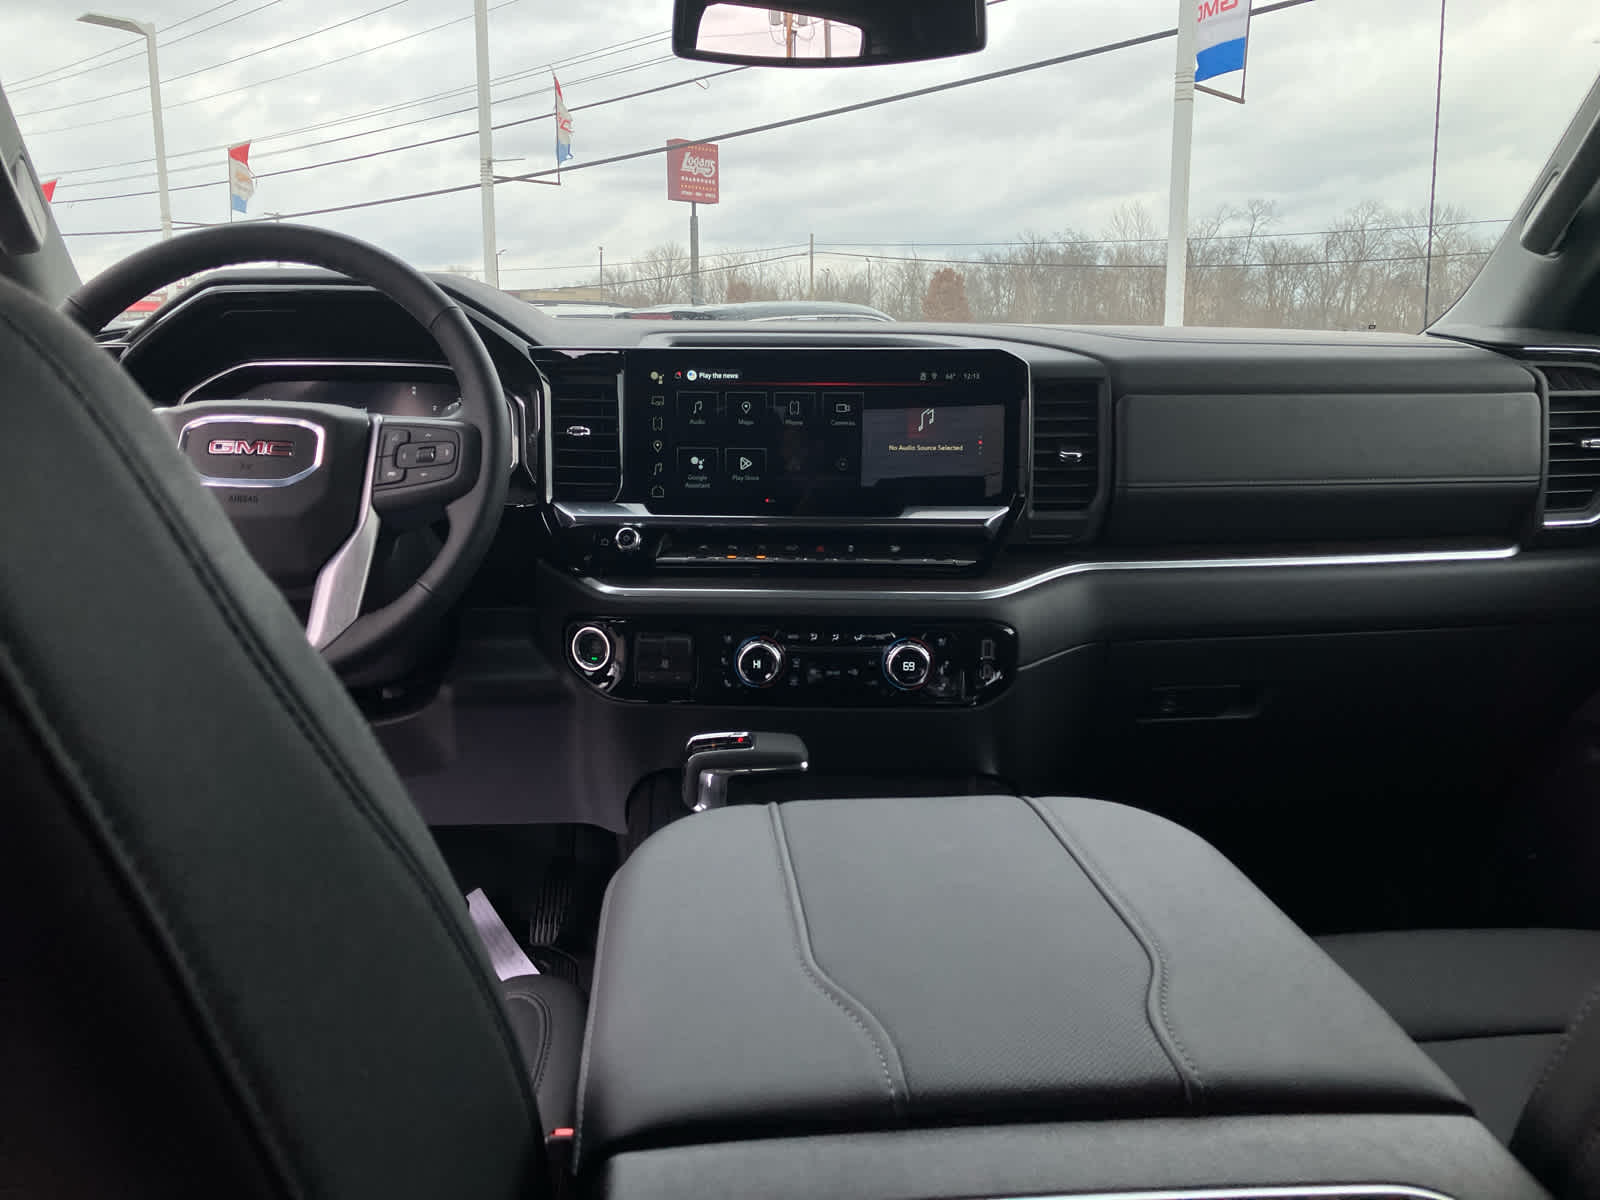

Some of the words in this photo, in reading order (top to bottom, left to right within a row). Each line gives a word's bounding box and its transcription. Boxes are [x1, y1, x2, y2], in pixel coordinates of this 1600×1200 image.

[699, 371, 711, 380] Play
[712, 371, 722, 379] the
[208, 439, 295, 456] GMC
[888, 443, 898, 451] No
[899, 443, 916, 451] Audio
[917, 443, 937, 451] Source
[939, 443, 964, 451] Selected
[902, 661, 916, 671] 69
